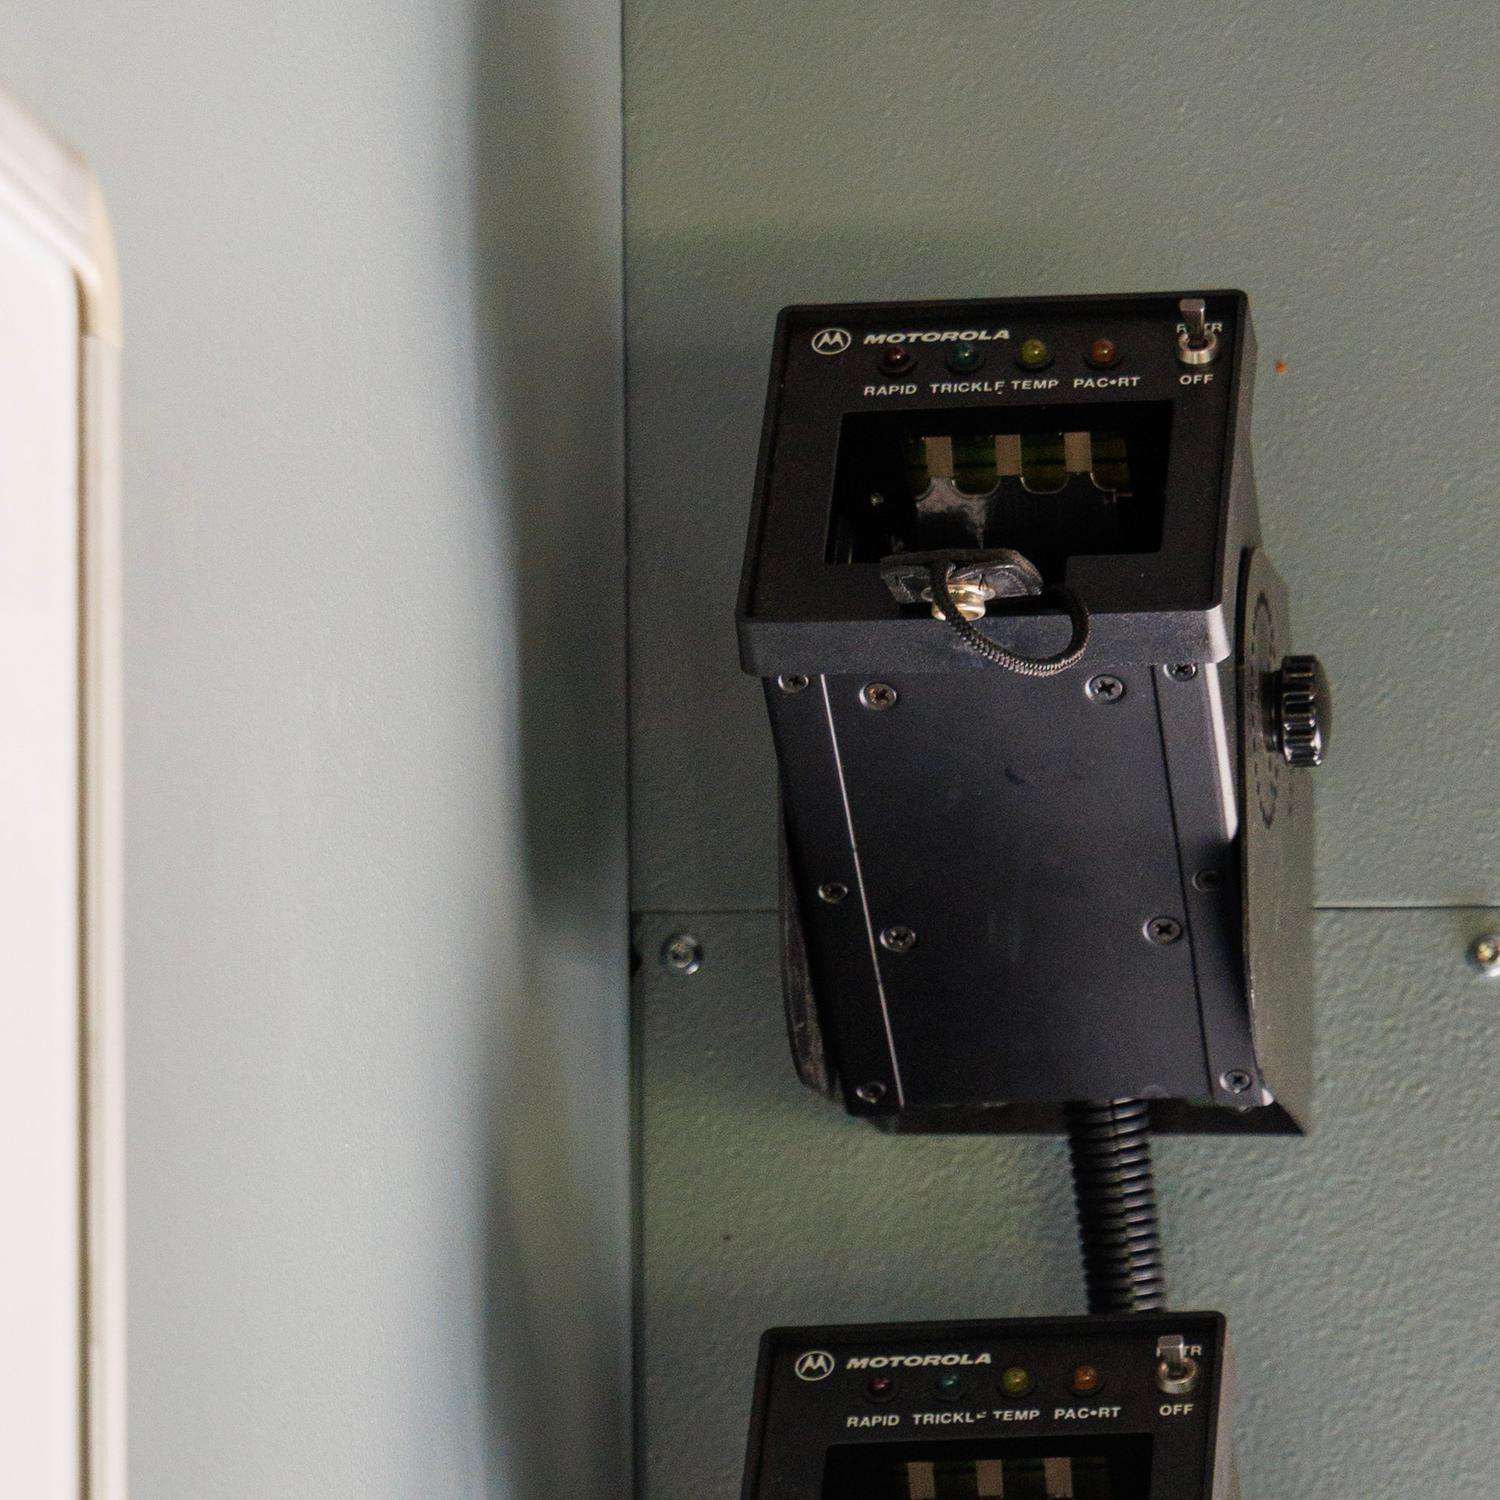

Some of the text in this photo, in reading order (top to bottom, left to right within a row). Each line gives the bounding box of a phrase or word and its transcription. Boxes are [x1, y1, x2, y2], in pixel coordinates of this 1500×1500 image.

[1176, 321, 1223, 333] RTR
[863, 328, 1010, 345] MOTOROLA
[1179, 374, 1214, 385] OFF
[863, 384, 917, 396] RAPID
[1011, 380, 1059, 390] TEMP
[846, 1353, 992, 1370] MOTOROLA
[1159, 1403, 1194, 1416] OFF
[846, 1415, 900, 1428] RAPID
[992, 1410, 1040, 1421] TEMP
